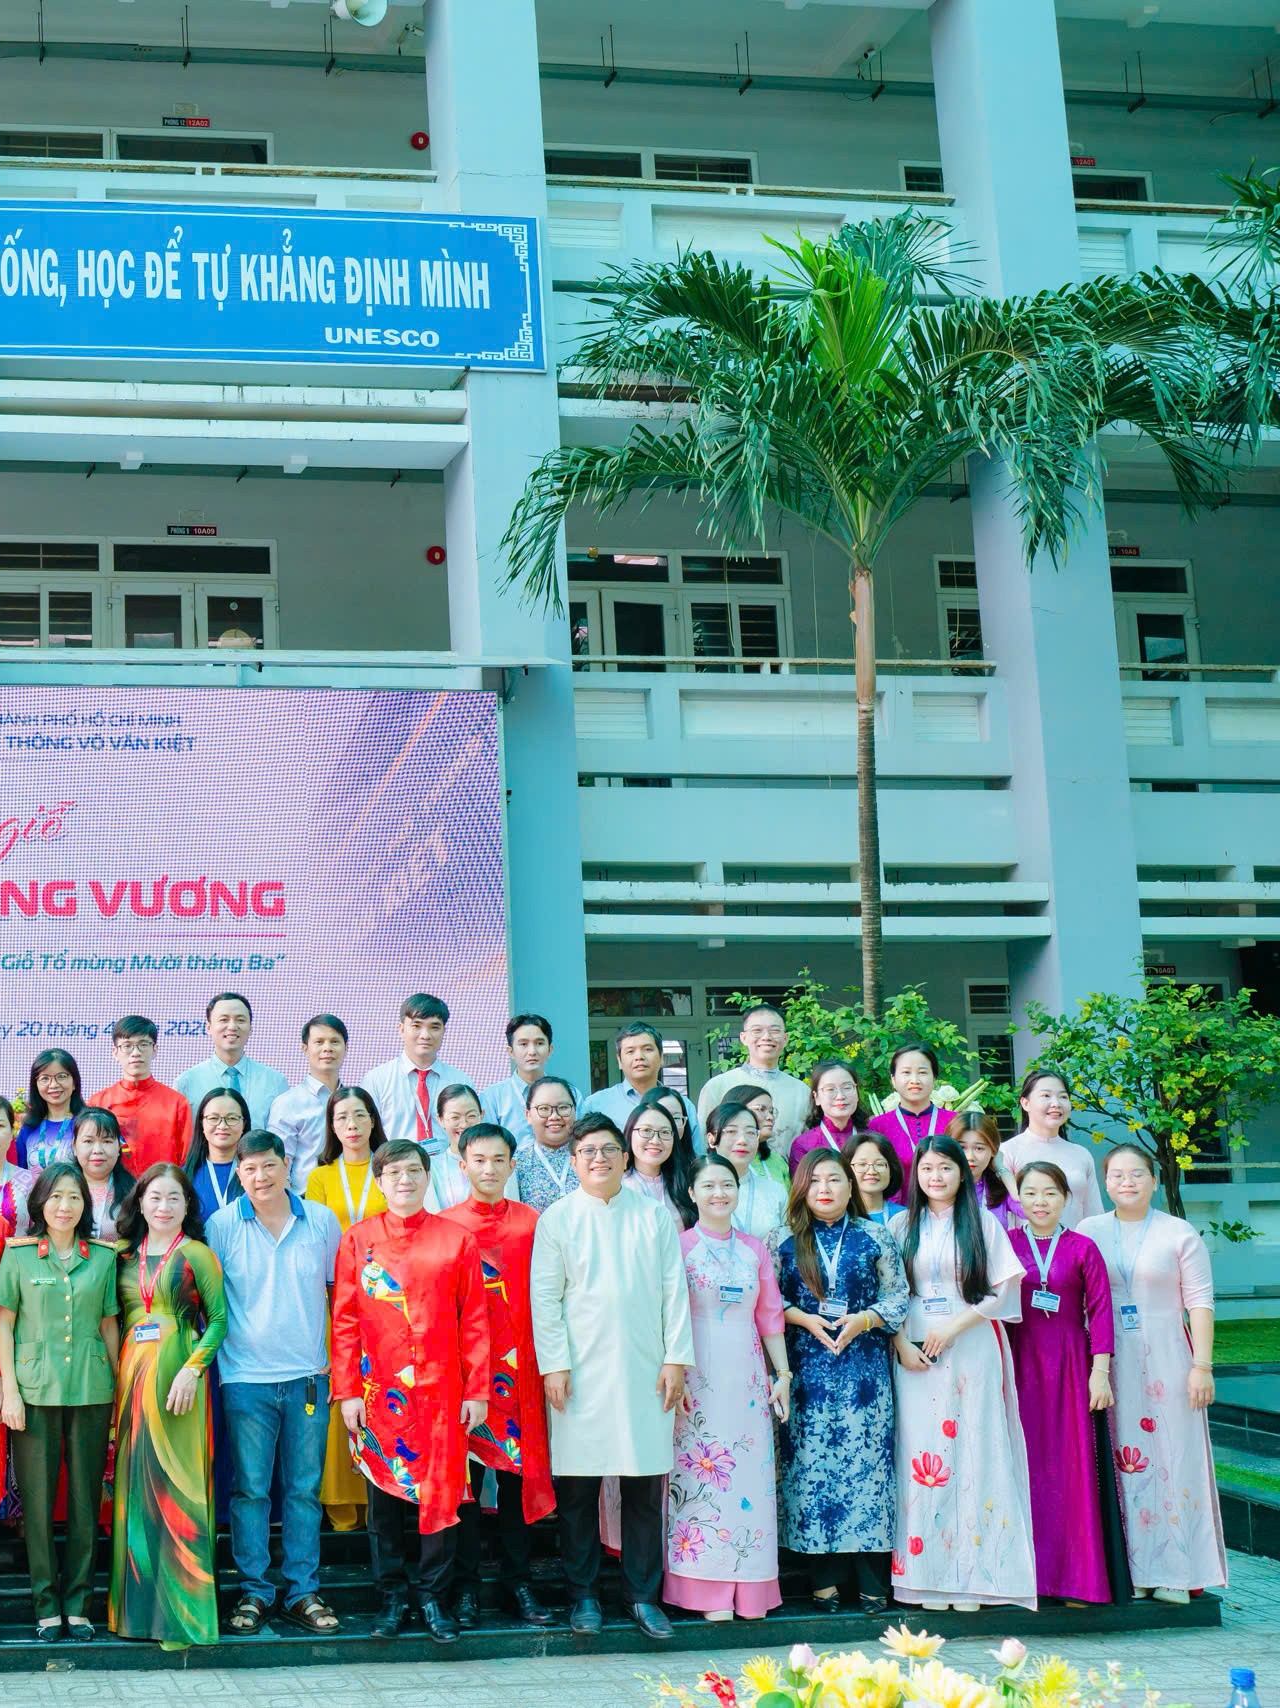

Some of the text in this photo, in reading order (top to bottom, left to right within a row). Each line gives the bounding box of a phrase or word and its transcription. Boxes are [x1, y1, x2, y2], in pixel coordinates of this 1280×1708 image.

[77, 250, 136, 308] HỌC
[144, 225, 183, 300] ĐỂ
[192, 243, 231, 311] TỰ
[240, 229, 336, 304] KHẲNG
[344, 257, 411, 317] ĐỊNH
[420, 248, 490, 310] MÌNH
[325, 327, 440, 348] UNESCO
[194, 527, 215, 535] 10A09
[43, 709, 77, 726] PHỐ
[109, 711, 135, 727] CHÍ
[139, 713, 181, 727] MINH
[5, 732, 72, 750] THÔNG
[110, 734, 149, 750] VĂN
[154, 733, 195, 752] KIỆT
[88, 874, 286, 918] VƯƠNG
[1, 950, 34, 970] Giỗ
[40, 949, 69, 970] Tổ
[70, 953, 126, 973] mùng
[130, 953, 183, 971] Mười
[186, 952, 243, 973] tháng
[17, 1021, 42, 1037] 20
[47, 1020, 99, 1040] tháng
